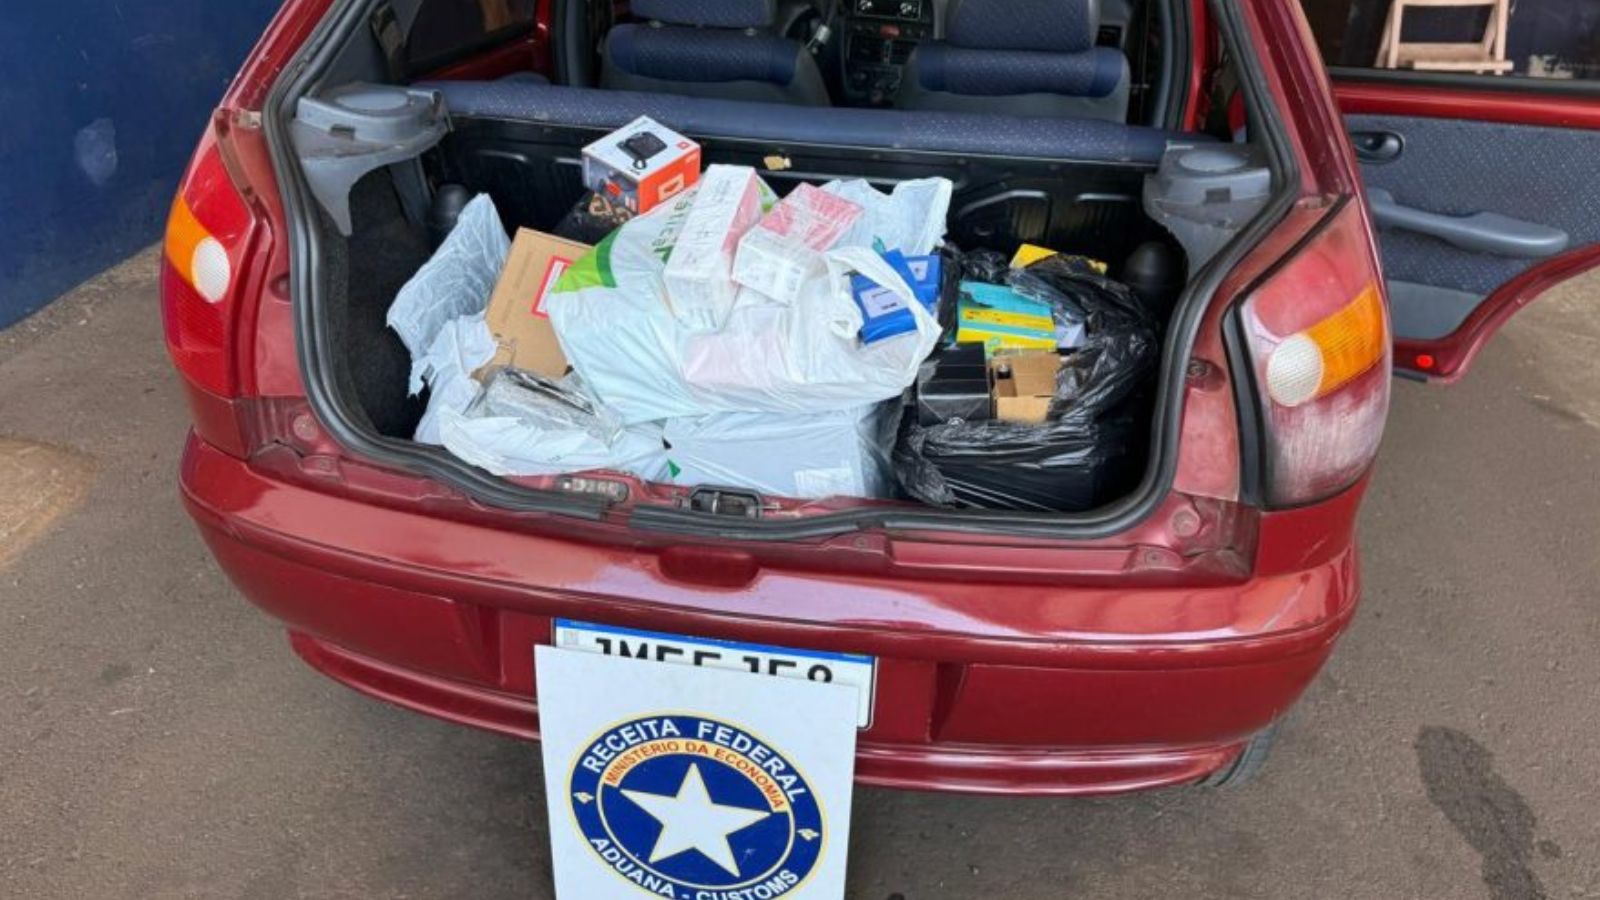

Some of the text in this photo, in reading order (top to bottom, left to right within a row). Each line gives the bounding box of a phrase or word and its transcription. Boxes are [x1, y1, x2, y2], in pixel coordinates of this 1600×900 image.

[582, 718, 806, 803] RECEITA FEDERAL
[685, 741, 709, 755] DA
[714, 747, 785, 808] ECONOMIA
[590, 837, 676, 899] ADUANA
[696, 869, 799, 900] CUSTOMS
